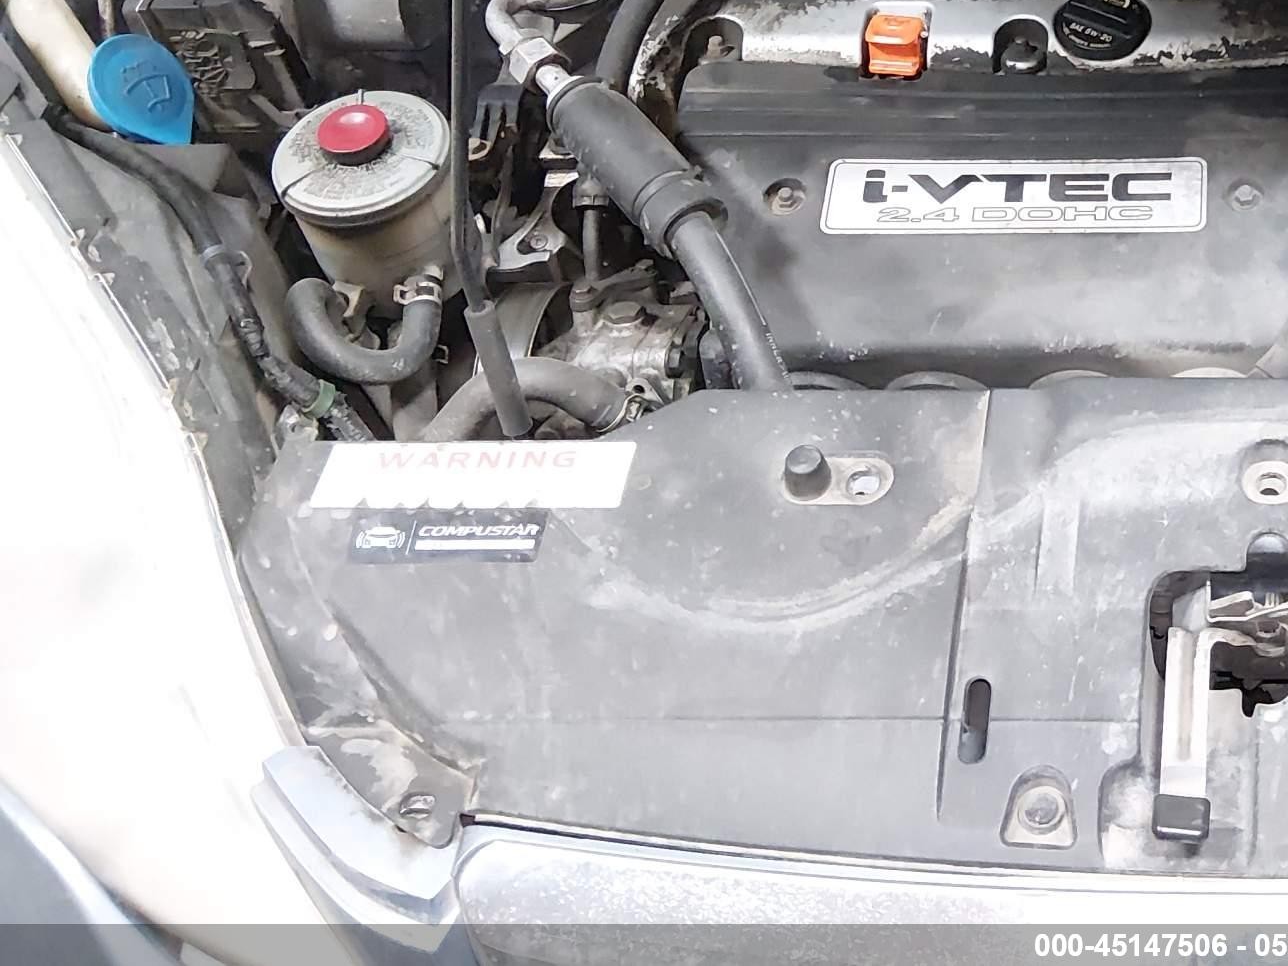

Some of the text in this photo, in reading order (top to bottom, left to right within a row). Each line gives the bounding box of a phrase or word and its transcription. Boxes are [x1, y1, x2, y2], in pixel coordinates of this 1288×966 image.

[862, 168, 1173, 205] i-VTEC
[877, 205, 1154, 223] 2.4 DOHC
[377, 450, 577, 469] WARNING
[418, 522, 541, 537] COMPUSTAR
